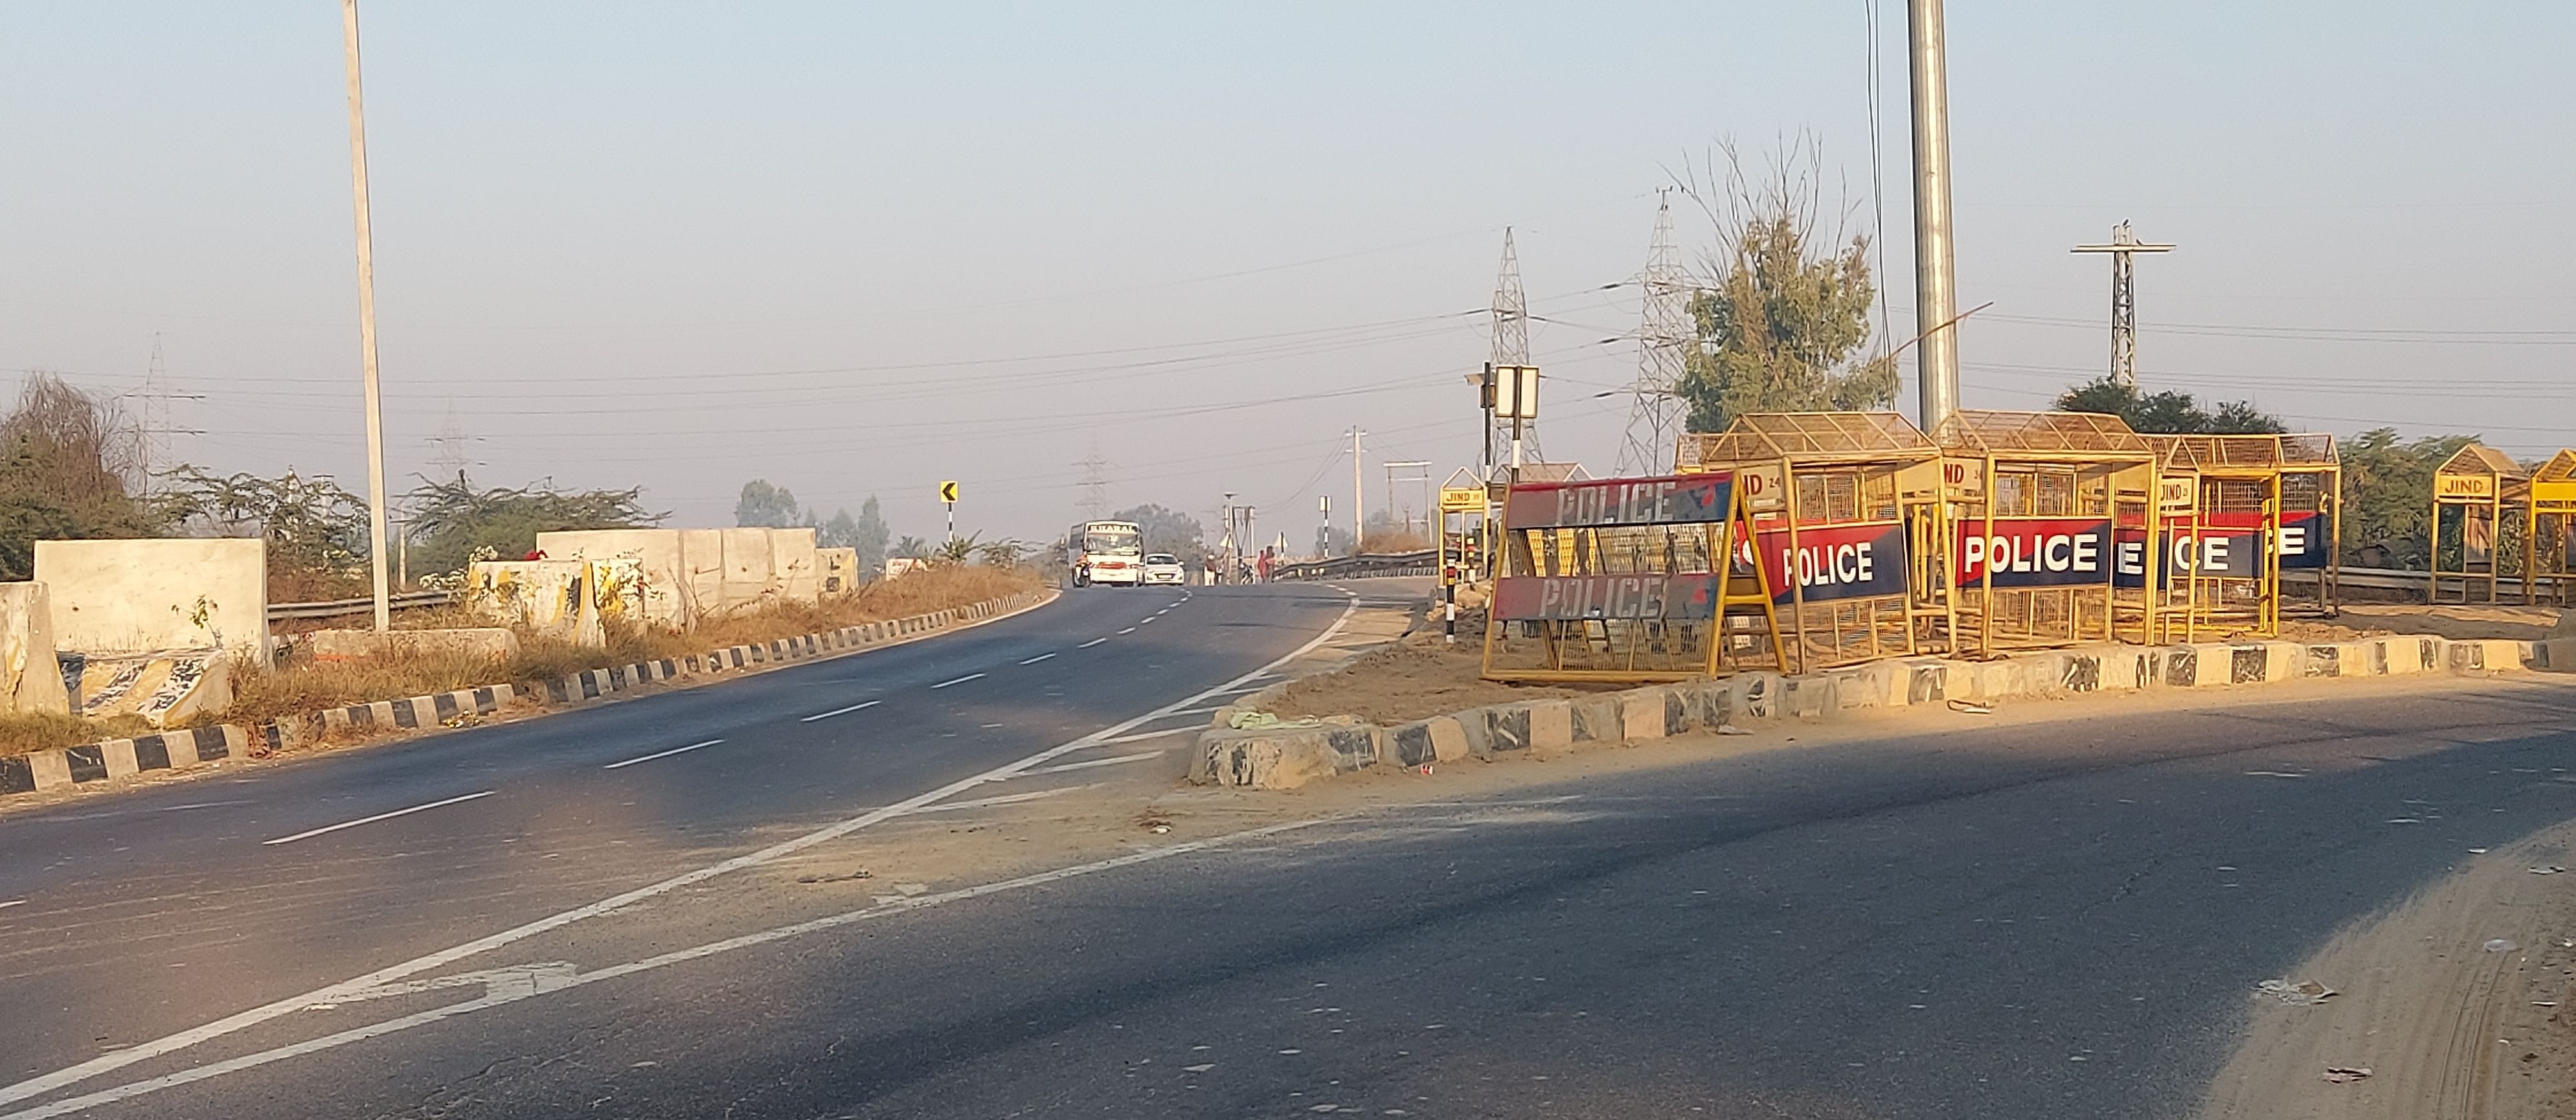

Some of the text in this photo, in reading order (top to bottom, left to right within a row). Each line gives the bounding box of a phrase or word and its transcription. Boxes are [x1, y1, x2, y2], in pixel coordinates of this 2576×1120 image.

[1447, 492, 1470, 501] JIND
[1556, 482, 1676, 526] POLICE
[2160, 484, 2181, 501] JIND
[2445, 480, 2483, 493] JIND
[1783, 542, 1873, 586] POLICE
[1965, 534, 2097, 573] POLICE
[1539, 578, 1663, 617] POLICE
